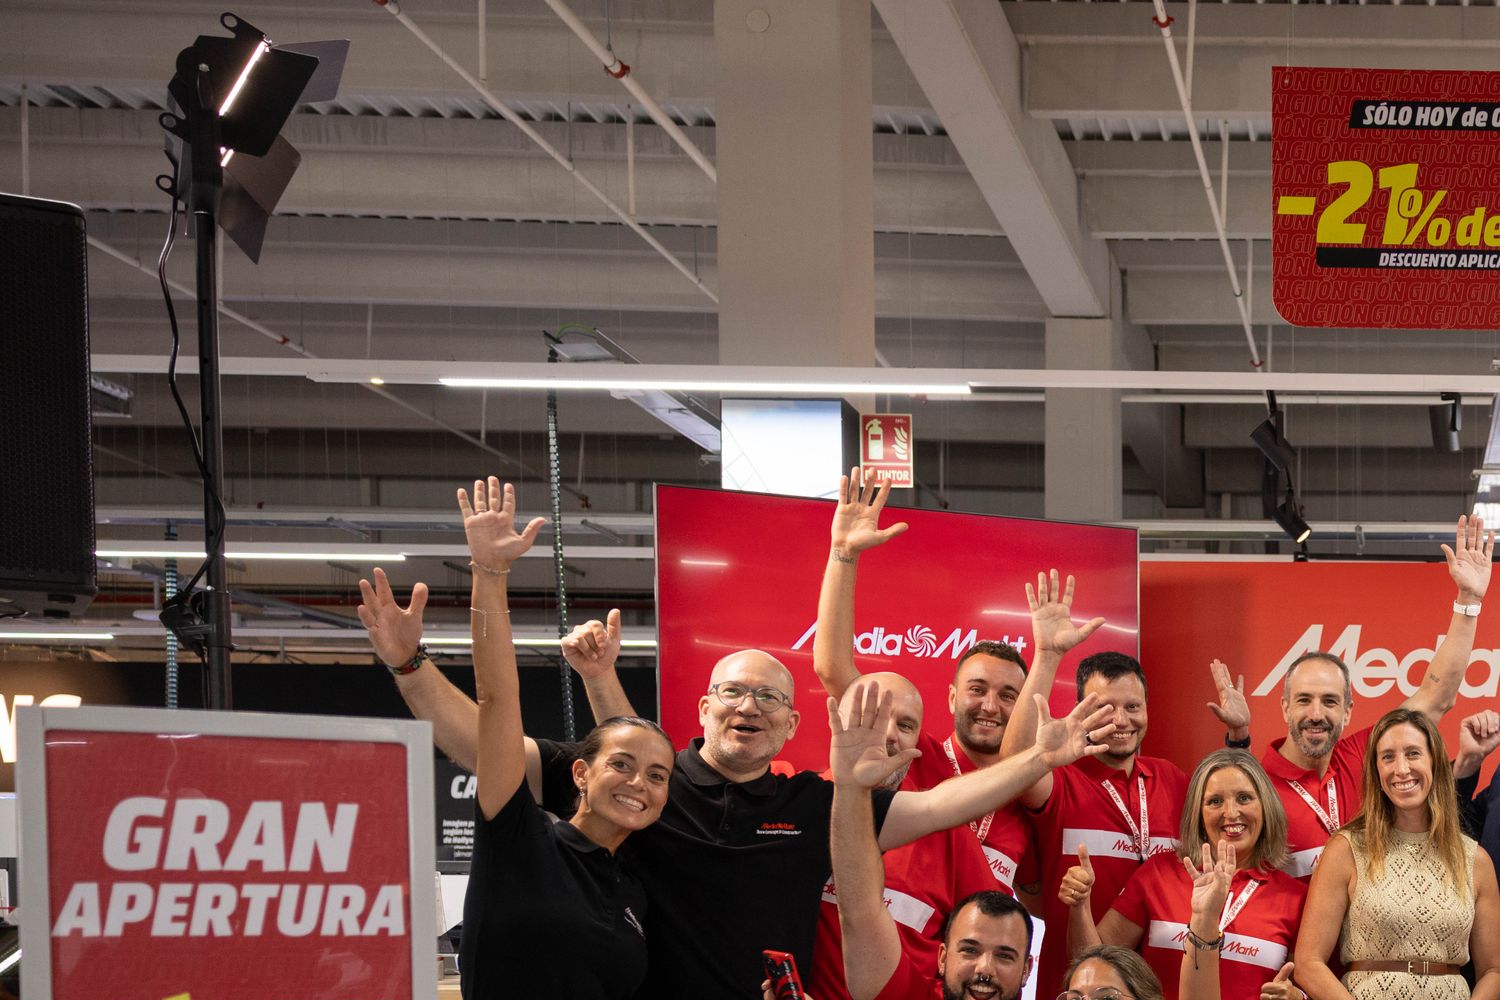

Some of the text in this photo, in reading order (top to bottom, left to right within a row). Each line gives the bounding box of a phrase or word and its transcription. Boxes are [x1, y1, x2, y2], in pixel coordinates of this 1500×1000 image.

[1363, 102, 1413, 126] SÓLO
[1415, 107, 1459, 127] HOY
[1461, 107, 1488, 127] de
[1278, 160, 1450, 246] -21%
[1379, 252, 1456, 268] DESCUENTO
[103, 796, 358, 873] GRAN
[51, 882, 405, 937] APERTURA
[1221, 941, 1259, 957] Markt
